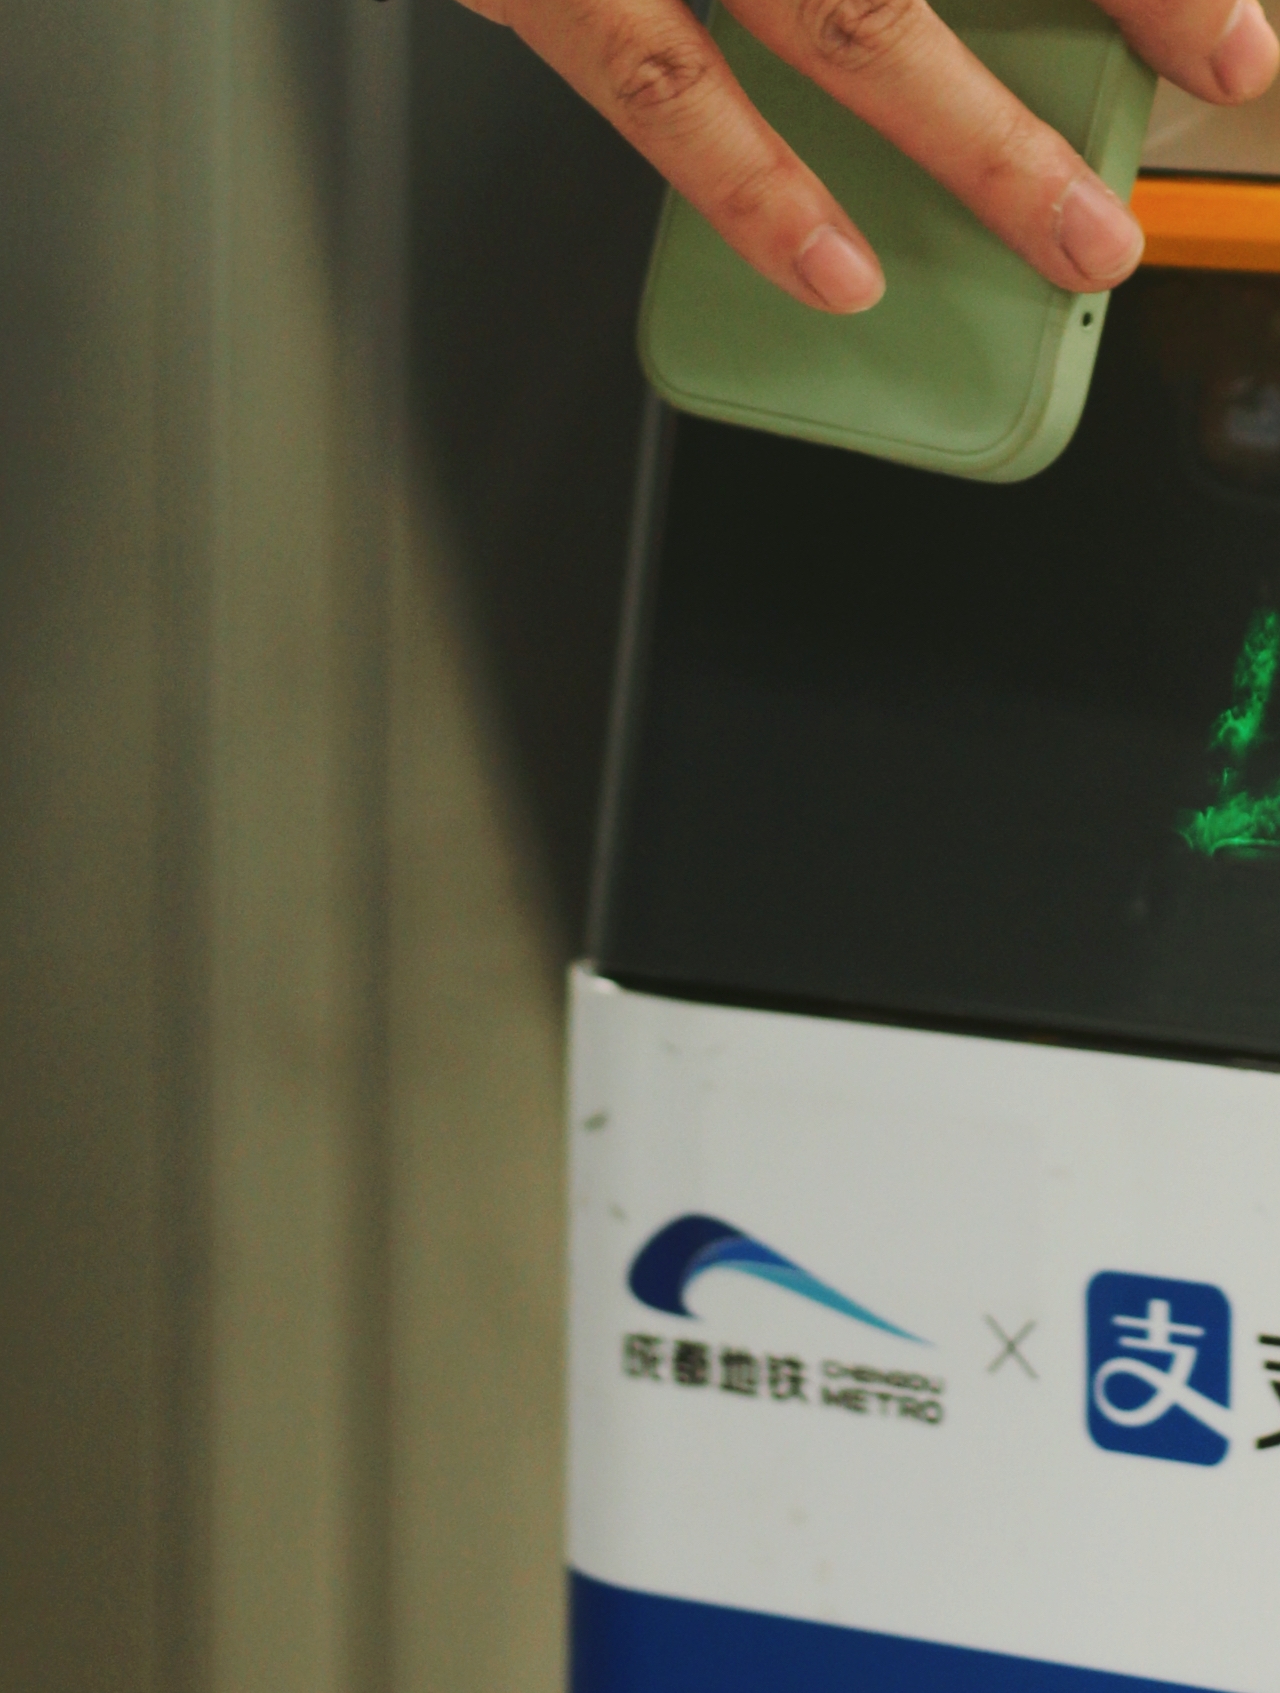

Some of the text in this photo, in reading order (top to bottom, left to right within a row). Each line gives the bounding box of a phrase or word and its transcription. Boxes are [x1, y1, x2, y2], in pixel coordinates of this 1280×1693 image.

[622, 1332, 807, 1403] 成都地铁
[822, 1387, 944, 1424] METRO
